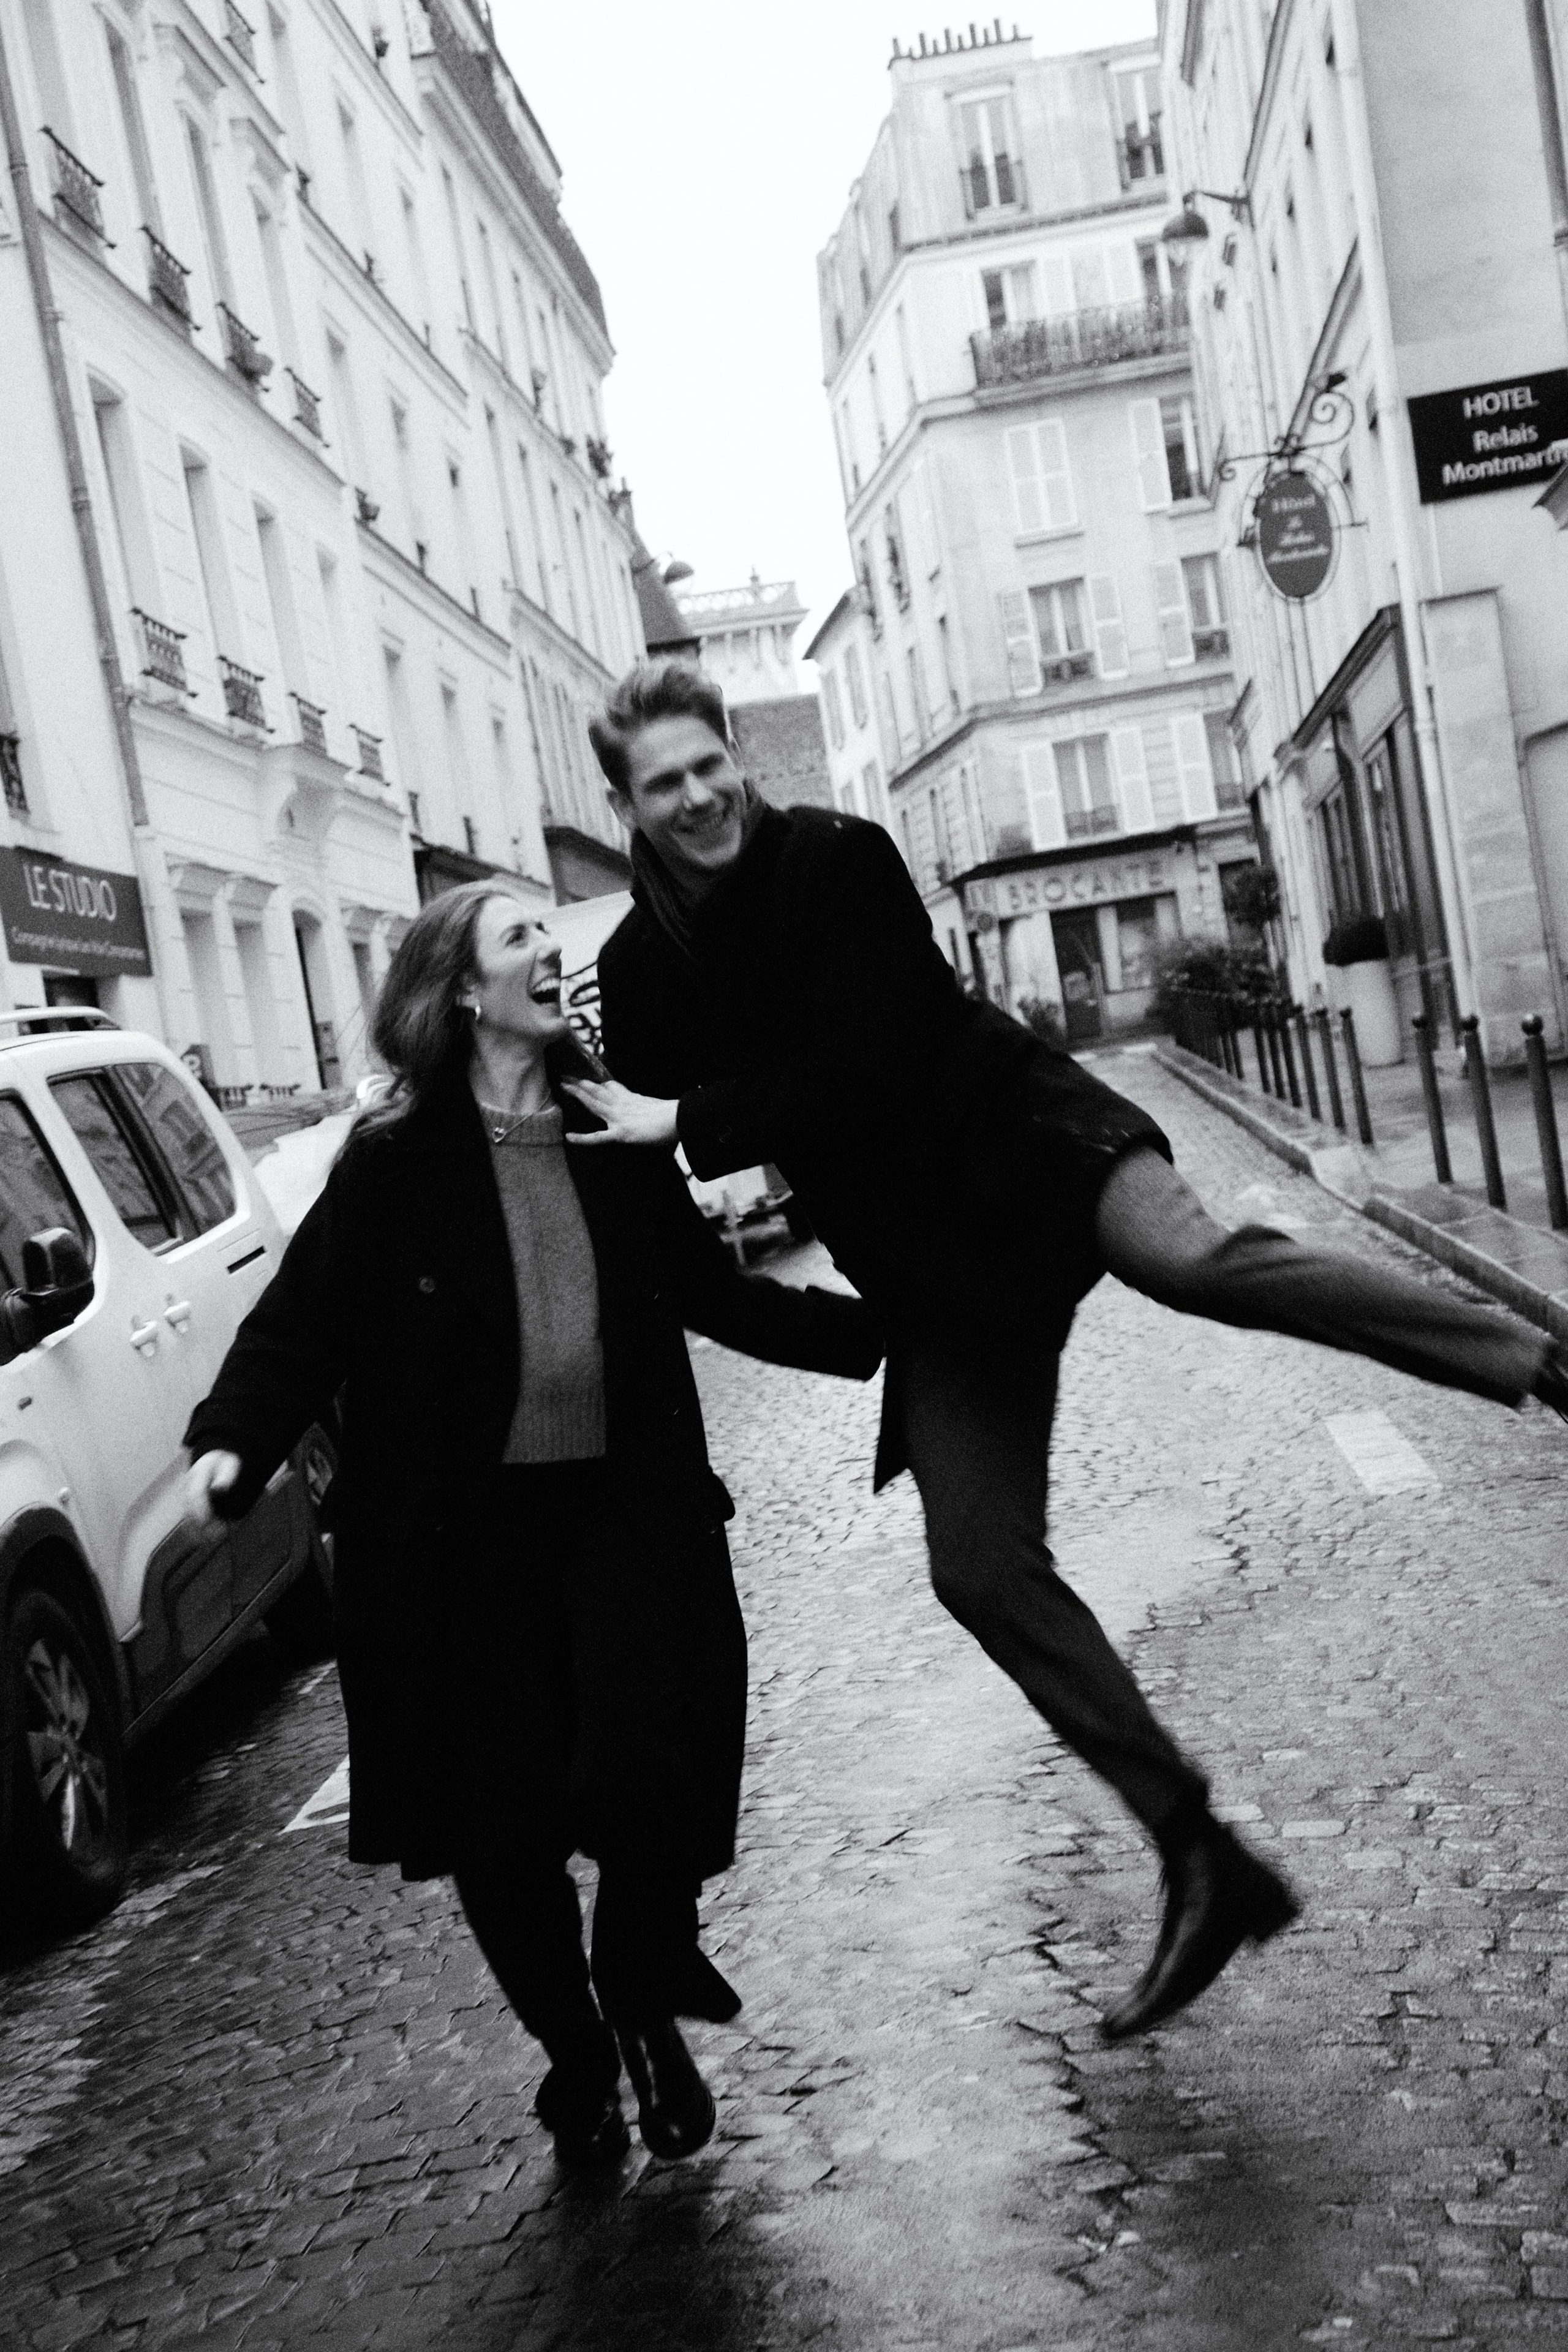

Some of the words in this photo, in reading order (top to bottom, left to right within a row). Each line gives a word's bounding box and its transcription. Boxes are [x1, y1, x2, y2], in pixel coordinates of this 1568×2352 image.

[1463, 386, 1540, 418] HOTEL
[1472, 423, 1539, 453] Relais
[1008, 859, 1165, 911] BROCANTE
